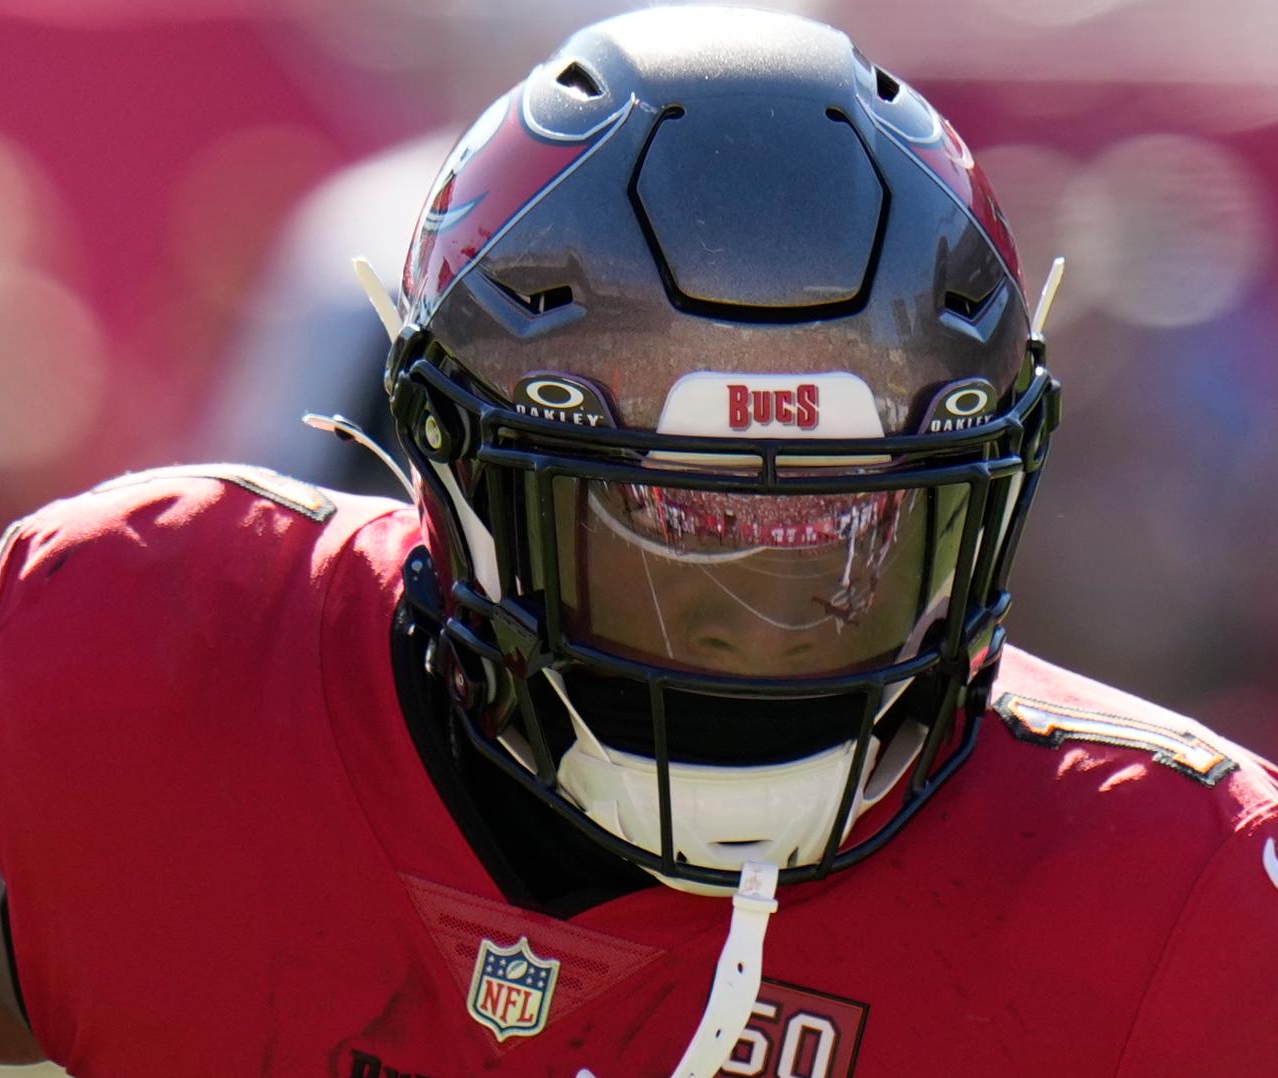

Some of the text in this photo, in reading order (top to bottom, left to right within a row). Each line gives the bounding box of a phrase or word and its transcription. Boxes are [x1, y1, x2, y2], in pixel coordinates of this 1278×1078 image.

[516, 404, 599, 426] OAKLEY
[726, 384, 820, 431] BUCS
[930, 415, 992, 432] OAKLEY
[480, 979, 534, 1023] NFL
